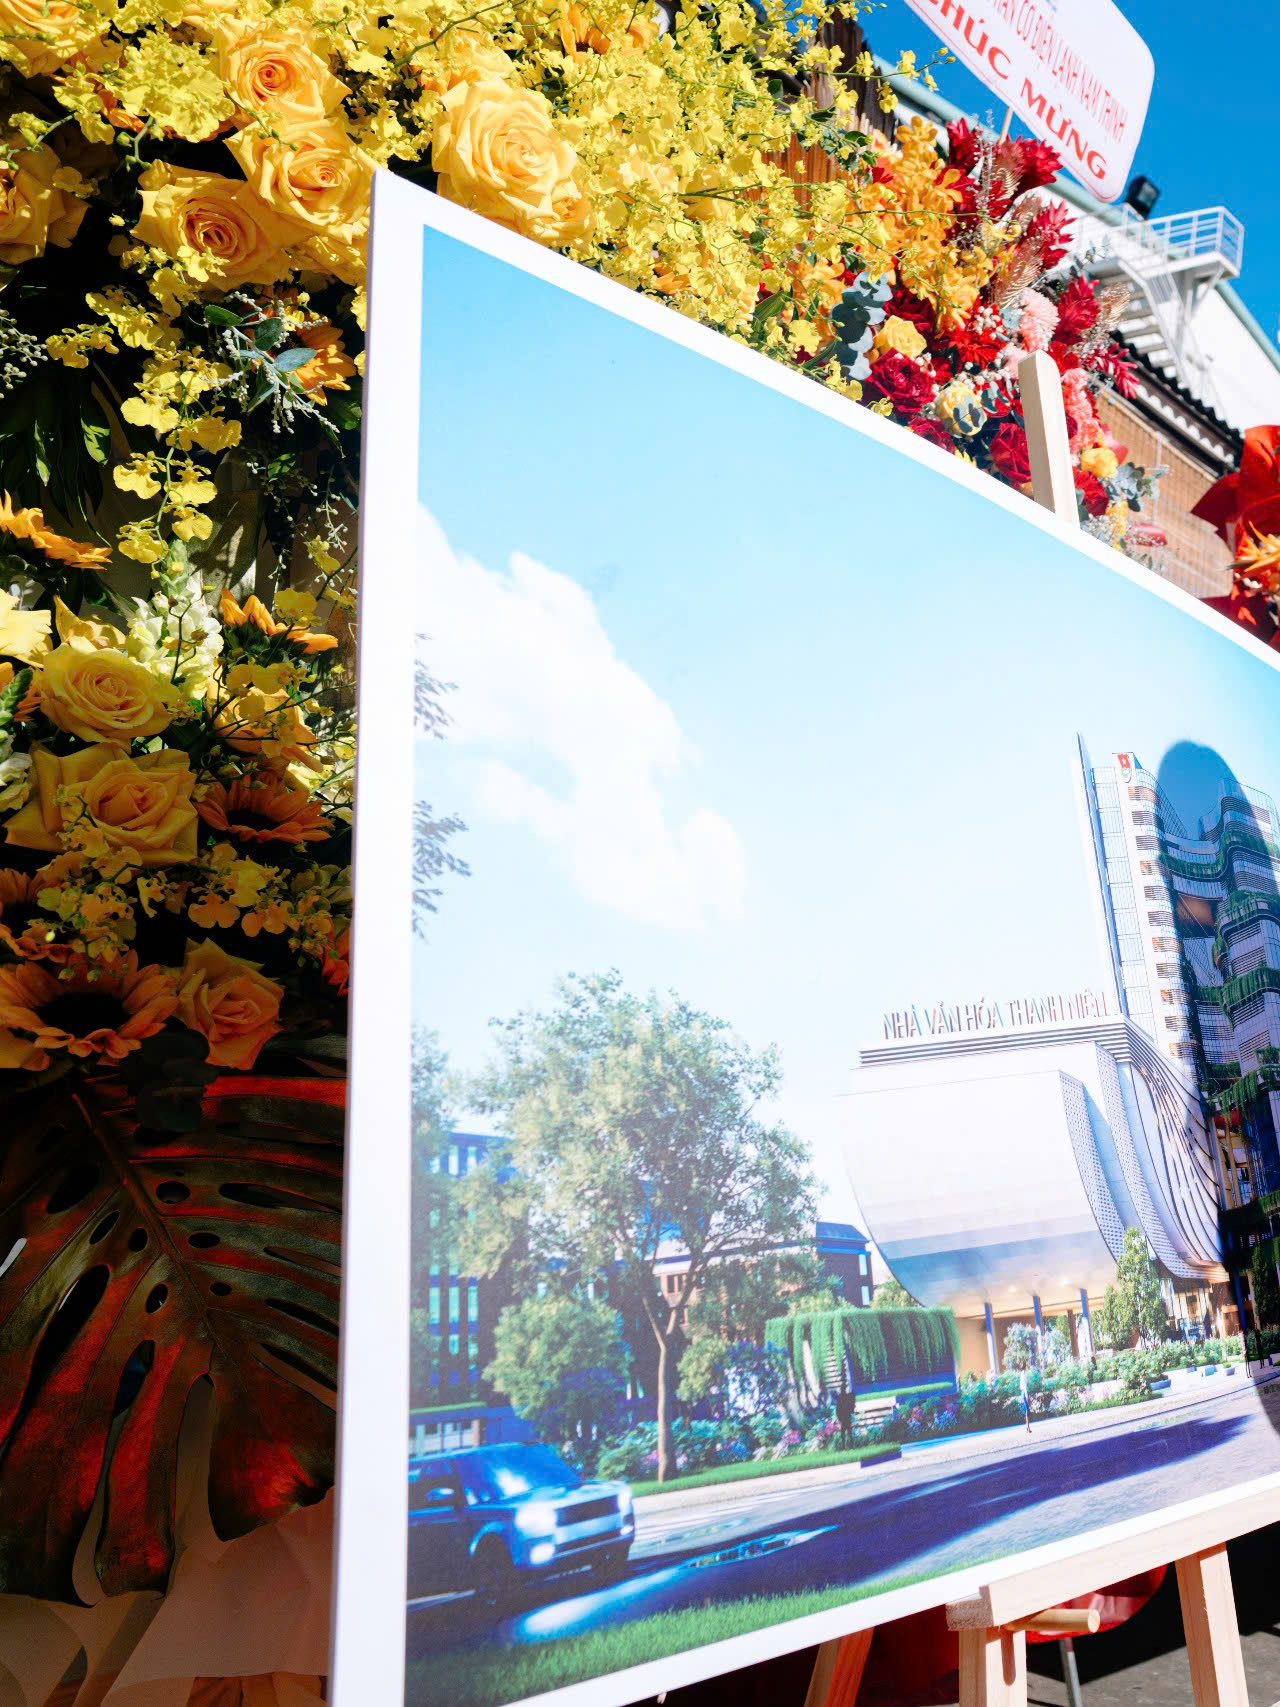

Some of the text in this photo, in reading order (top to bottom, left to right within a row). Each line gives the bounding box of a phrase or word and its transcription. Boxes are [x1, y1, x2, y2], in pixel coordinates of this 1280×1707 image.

[928, 0, 1107, 180] HÚC MỪNG
[883, 1003, 922, 1040] NHÀ
[965, 996, 1004, 1031] HÓA
